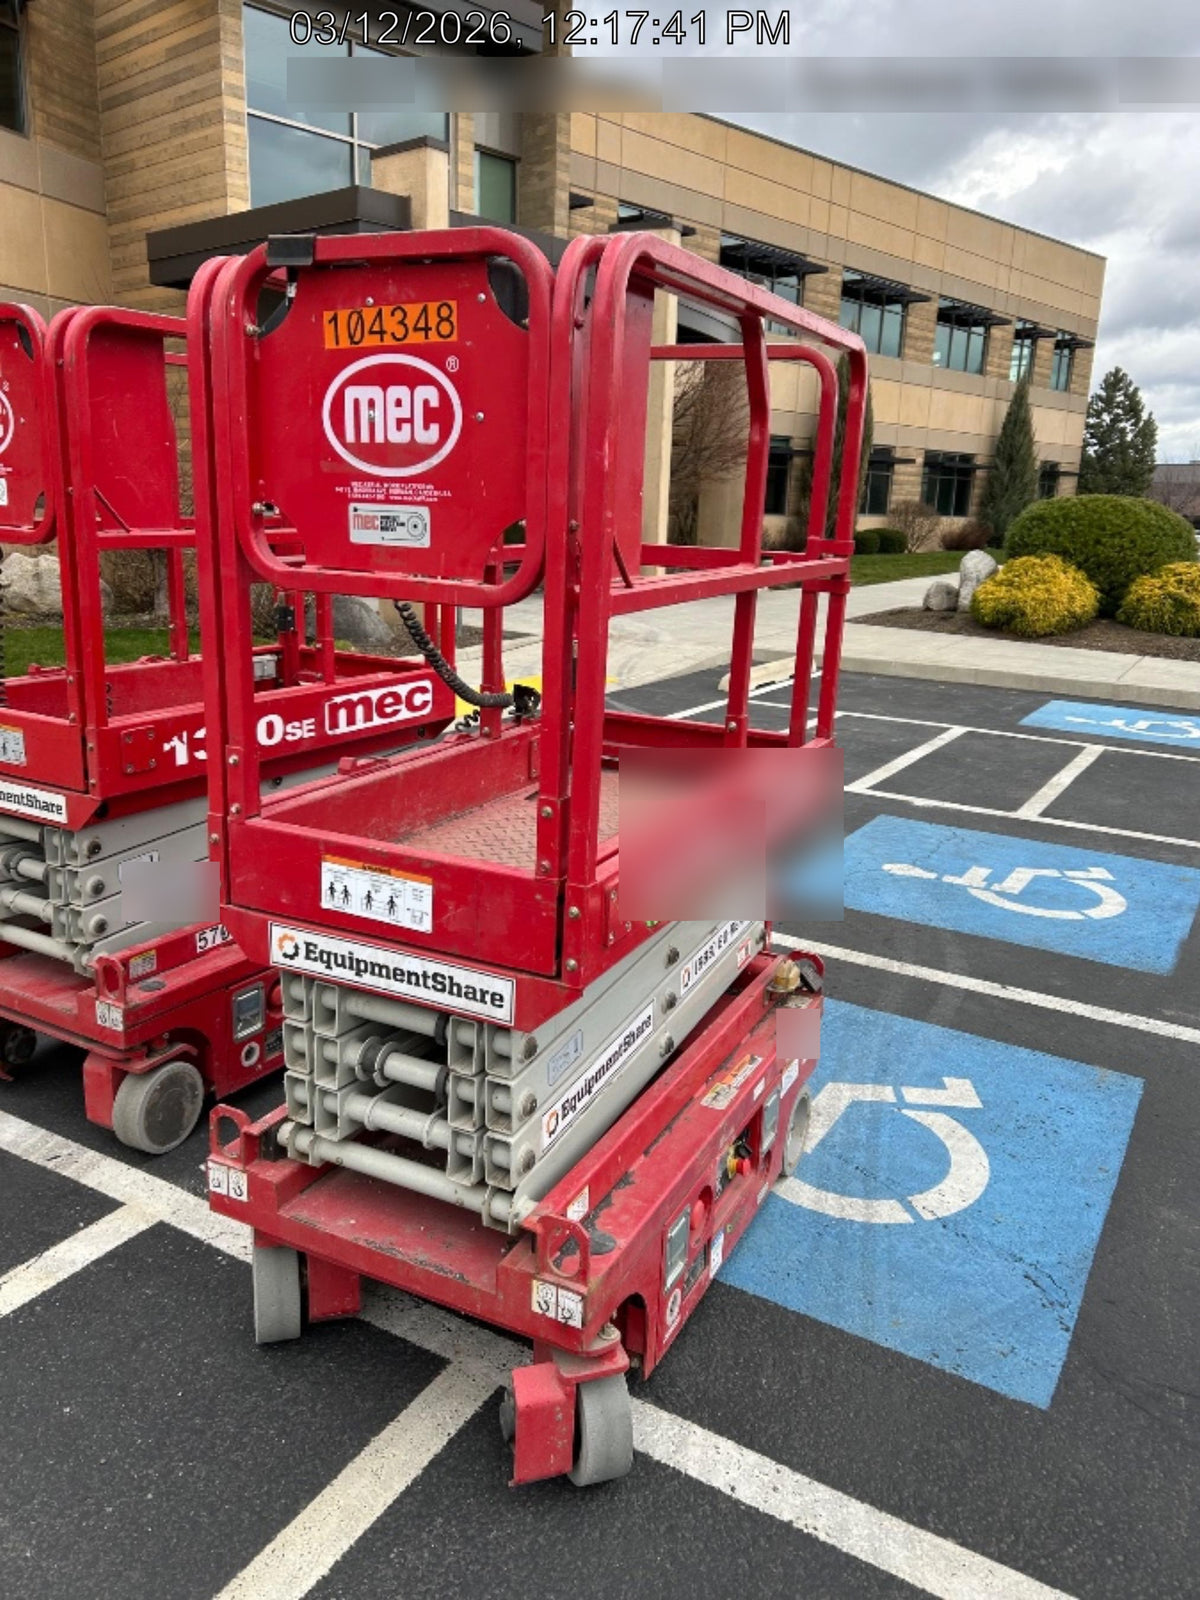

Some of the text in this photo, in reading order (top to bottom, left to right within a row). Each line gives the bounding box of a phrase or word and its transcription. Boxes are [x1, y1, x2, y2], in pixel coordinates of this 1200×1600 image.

[328, 302, 455, 346] 104348
[344, 385, 440, 445] mec
[328, 685, 431, 729] mec
[303, 941, 505, 1009] EquipmentShare
[561, 1014, 652, 1119] EquipmentShare
